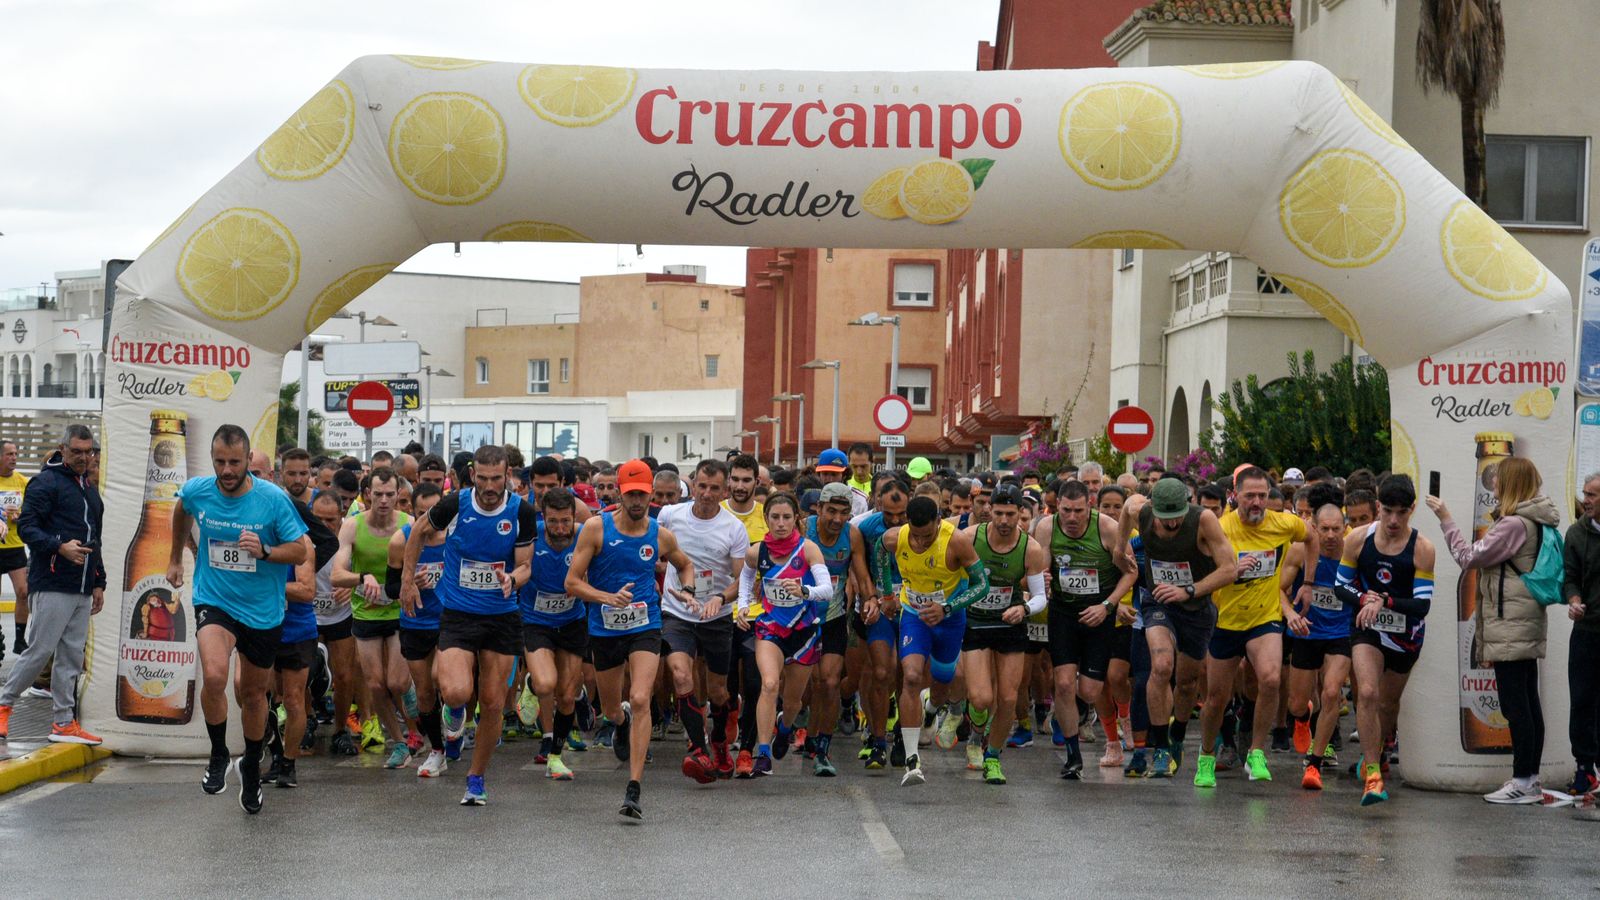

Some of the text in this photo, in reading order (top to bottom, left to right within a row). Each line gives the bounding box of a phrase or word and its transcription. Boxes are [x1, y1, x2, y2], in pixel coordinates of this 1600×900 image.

[739, 83, 825, 94] DESDE
[635, 84, 1022, 159] Cruzcampo
[671, 163, 860, 226] Radler
[111, 335, 251, 371] Cruzcampo
[1417, 355, 1566, 387] Cruzcampo
[118, 370, 187, 400] Radler
[1431, 393, 1513, 423] Radler
[328, 431, 347, 439] Playa
[148, 468, 185, 483] Radler
[4, 496, 17, 505] 282
[205, 517, 231, 528] Yolanda
[223, 549, 239, 562] 88
[470, 570, 493, 583] 318
[1160, 570, 1180, 581] 381
[1068, 577, 1088, 589] 220
[772, 589, 793, 601] 152
[980, 595, 1001, 605] 245
[1314, 592, 1333, 604] 126
[313, 598, 333, 609] 292
[544, 599, 566, 609] 125
[613, 611, 637, 625] 294
[1029, 624, 1046, 636] 211
[121, 643, 195, 666] Cruzcampo
[134, 665, 175, 681] Radler
